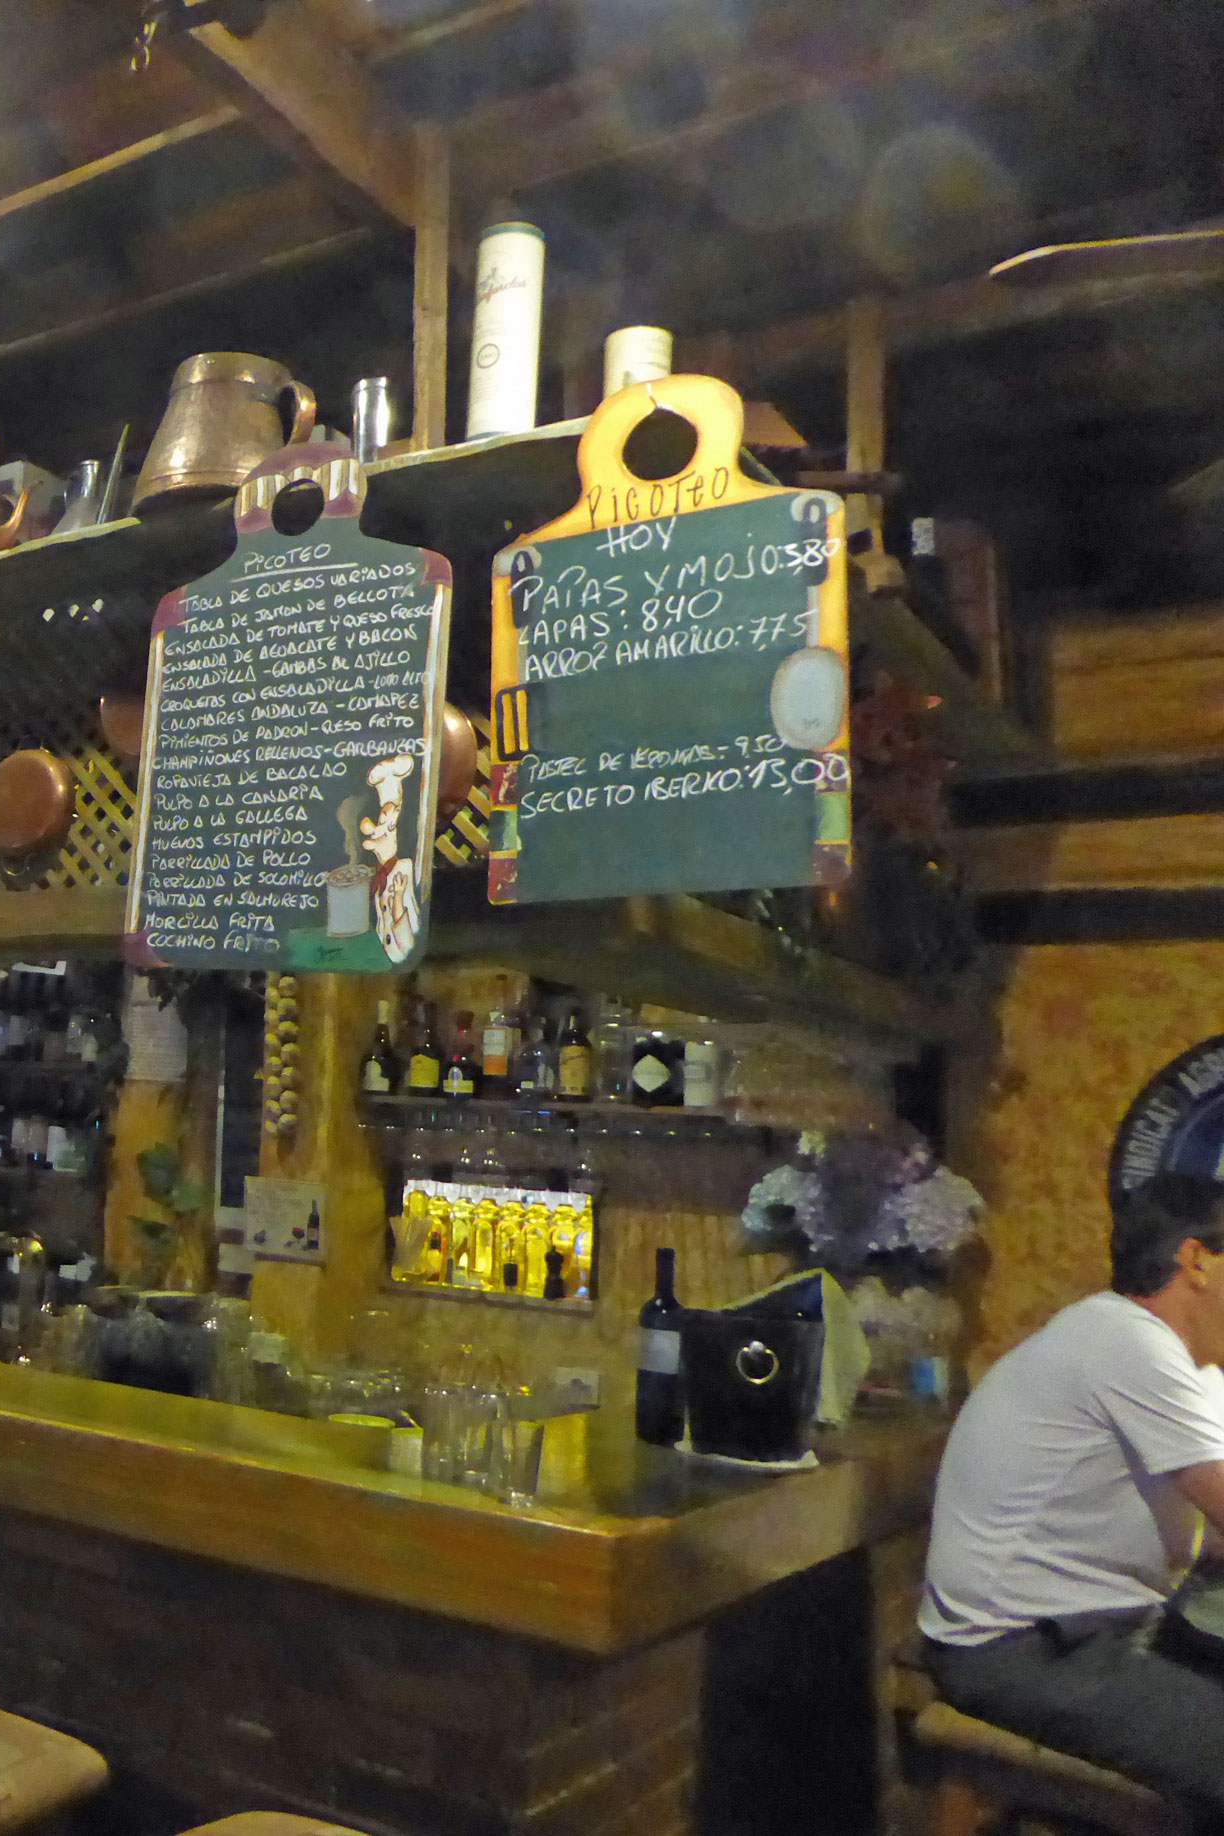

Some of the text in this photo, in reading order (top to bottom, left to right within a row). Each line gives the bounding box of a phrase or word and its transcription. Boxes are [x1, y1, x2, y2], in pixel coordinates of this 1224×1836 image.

[587, 466, 729, 530] PICOTEO
[596, 516, 676, 557] HOY
[244, 543, 331, 574] PICOTEO
[178, 562, 416, 612] TABLA DE QUESOS VARIADOS
[508, 565, 629, 615] PAPAS
[644, 564, 670, 596] Y
[177, 584, 415, 634] TABLA DE JAMON DE BELLOTA
[641, 588, 724, 633] 8,40
[164, 602, 435, 656] ENSALADA DE TOMATE Y QUESO FRESCO
[162, 652, 227, 674] ENSALADA
[233, 649, 254, 663] DE
[345, 632, 356, 649] Y
[358, 623, 418, 646] BACON
[525, 641, 608, 682] ARROZ
[162, 665, 256, 692] ENSALADILLA
[331, 655, 349, 670] AL
[354, 650, 410, 671] AJILLO
[160, 694, 226, 712] CROQUETAS
[232, 688, 256, 703] CON
[260, 676, 365, 700] ENSALADILLA
[158, 733, 228, 750] PIMIENTOS
[232, 728, 250, 744] DE
[256, 722, 308, 740] PADRON
[368, 712, 414, 729] FRITO
[160, 709, 245, 731] CALAMARES
[251, 702, 328, 720] ANDALUZA
[152, 749, 250, 770] CHAMPIÑONES
[256, 745, 322, 761] RELLENOS
[520, 753, 588, 783] PASTEL
[598, 752, 624, 772] DE
[157, 762, 347, 789] ROPAVIEJA DE BACALAO
[153, 784, 324, 811] PULPO A LA CANARIA
[520, 784, 636, 819] SECRETO
[153, 805, 308, 831] PULPO A LA GALLEGA
[152, 827, 317, 851] HUEVOS ESTAMPIDOS
[150, 848, 311, 871] PARRILLADA DE POLLO
[233, 871, 253, 887] DE
[258, 869, 328, 887] SOLOMILLO
[213, 893, 233, 907] EN
[144, 911, 275, 931] MORCILLA FRITA
[146, 932, 216, 950] COCHINO
